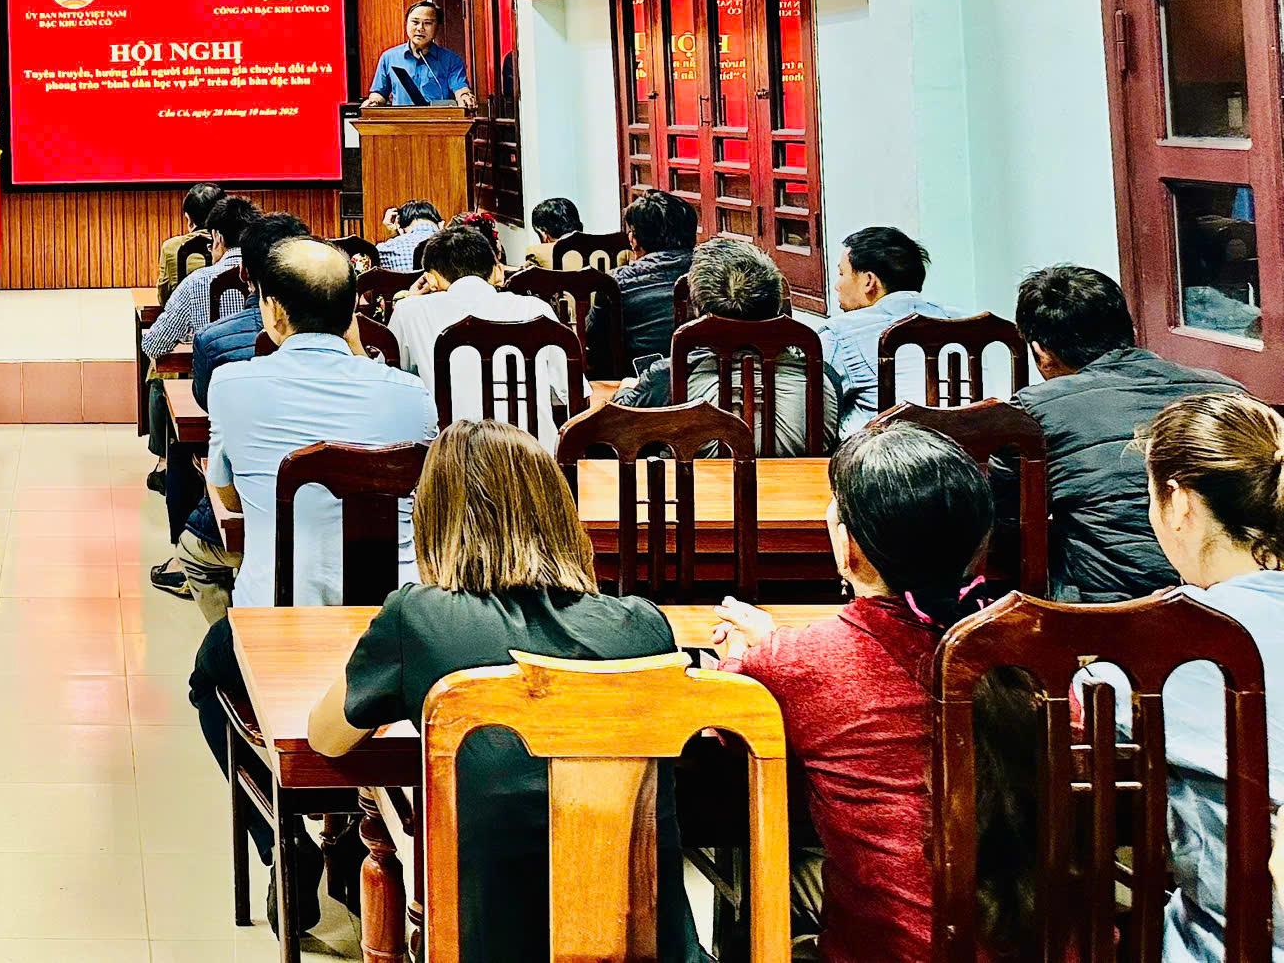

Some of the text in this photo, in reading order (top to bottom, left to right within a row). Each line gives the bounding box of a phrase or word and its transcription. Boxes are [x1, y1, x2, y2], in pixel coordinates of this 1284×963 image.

[39, 12, 57, 20] BAN
[58, 11, 84, 20] MTTQ
[85, 10, 105, 20] VIỆT
[107, 10, 127, 18] NAM
[213, 5, 239, 15] CÔNG
[274, 6, 294, 14] KHU
[59, 19, 77, 28] KHU
[109, 40, 243, 66] HỘI NGHỊ
[24, 62, 332, 80] Tuyên truyền, hướng dẫn người dân tham gia chuyển đổi số và
[45, 81, 77, 92] phong
[78, 81, 99, 89] trào
[132, 79, 151, 88] dân
[153, 79, 171, 89] học
[173, 80, 186, 90] vụ
[207, 77, 228, 87] trên
[230, 76, 246, 88] địa
[249, 76, 268, 86] bàn
[270, 76, 288, 87] đặc
[290, 76, 310, 85] khu
[192, 109, 212, 118] ngày
[224, 108, 247, 118] tháng
[259, 108, 278, 116] năm
[278, 107, 298, 116] 2025
